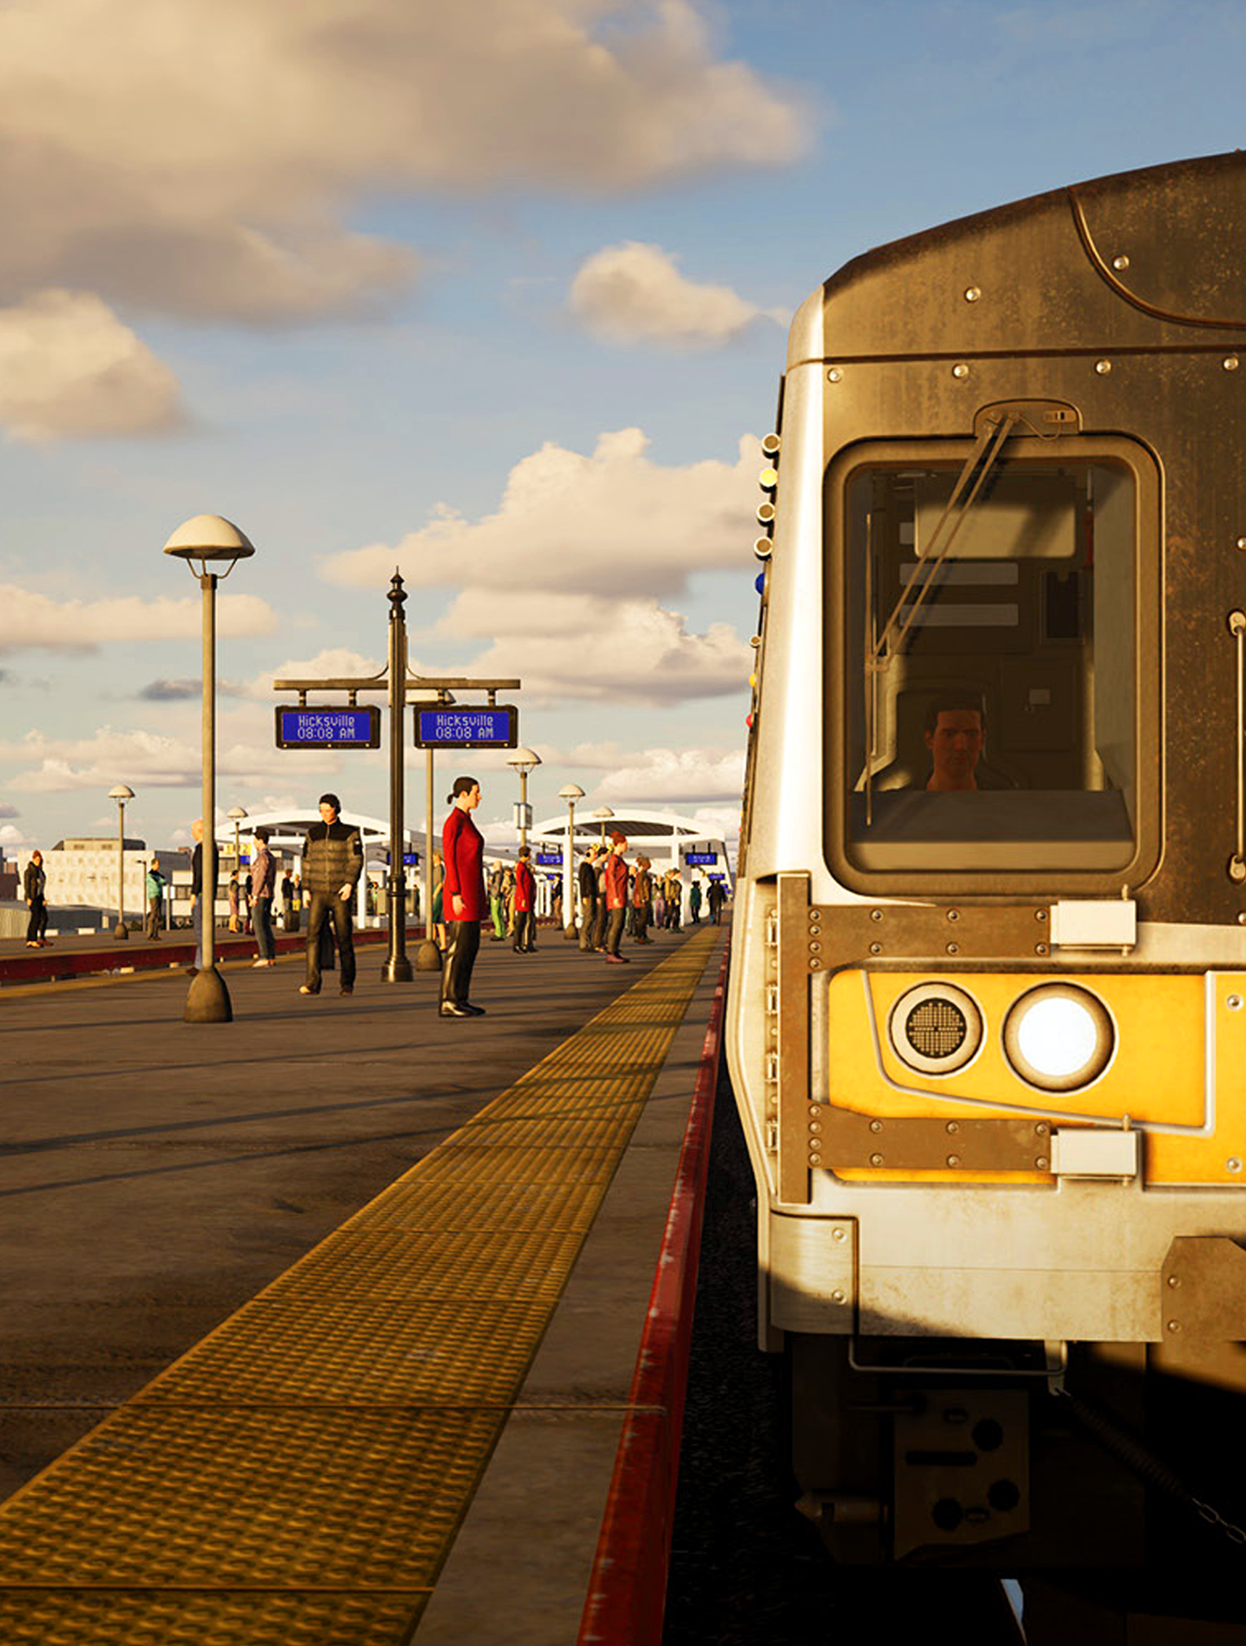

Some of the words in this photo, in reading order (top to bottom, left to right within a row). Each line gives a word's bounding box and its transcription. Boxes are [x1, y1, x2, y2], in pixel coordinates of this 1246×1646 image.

[298, 715, 355, 727] Hicksville
[436, 714, 494, 726] Hicksville
[297, 727, 333, 739] 08:08
[339, 727, 355, 739] AM
[435, 726, 472, 739] 08:08
[477, 727, 494, 739] AM
